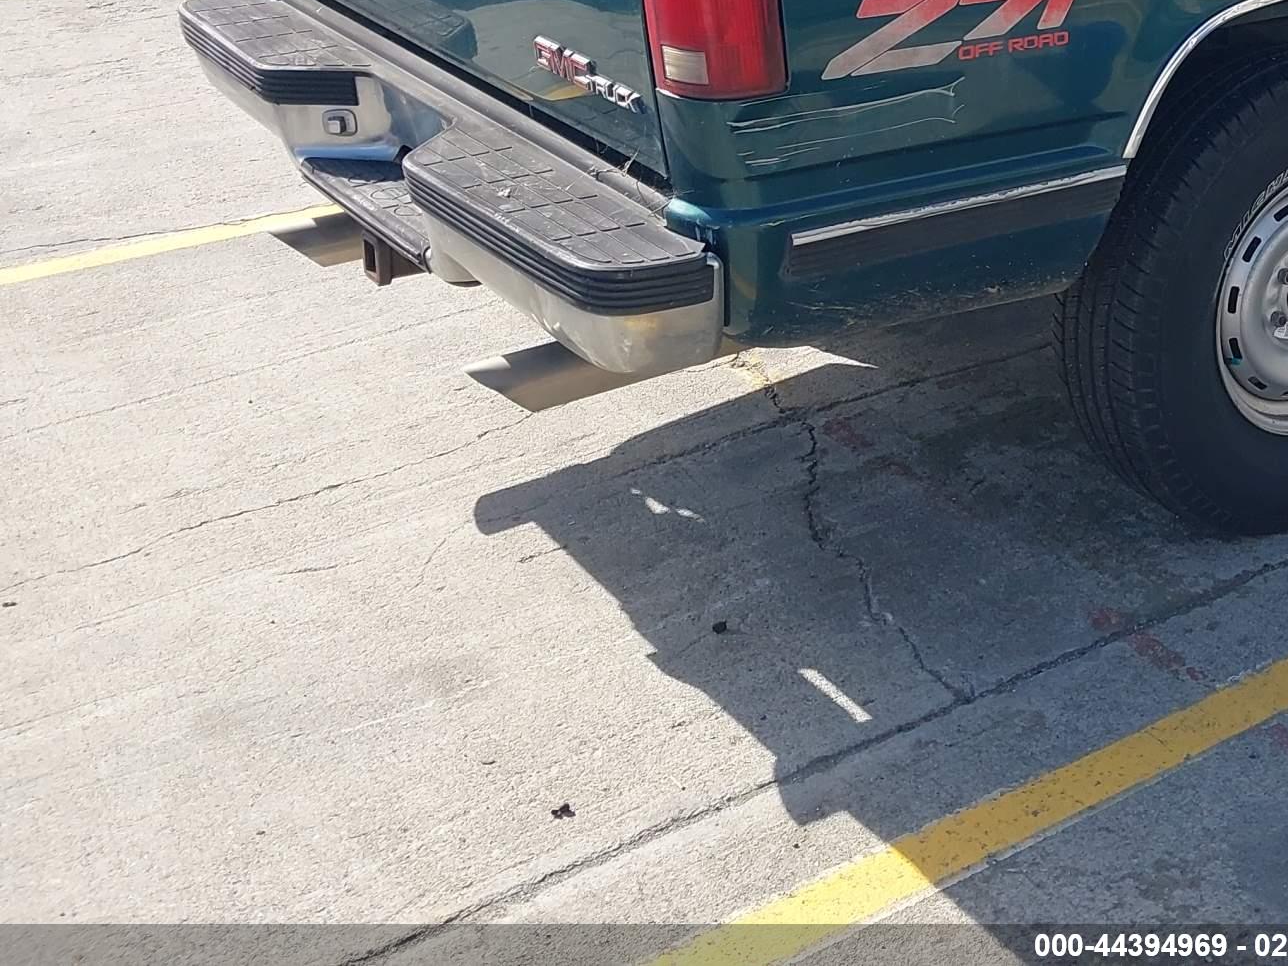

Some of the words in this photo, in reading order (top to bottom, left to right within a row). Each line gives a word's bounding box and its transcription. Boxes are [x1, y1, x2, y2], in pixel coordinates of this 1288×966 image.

[958, 42, 1003, 61] OFF
[1008, 31, 1069, 52] ROAD
[533, 35, 593, 91] GMC
[585, 75, 641, 113] TRUCK
